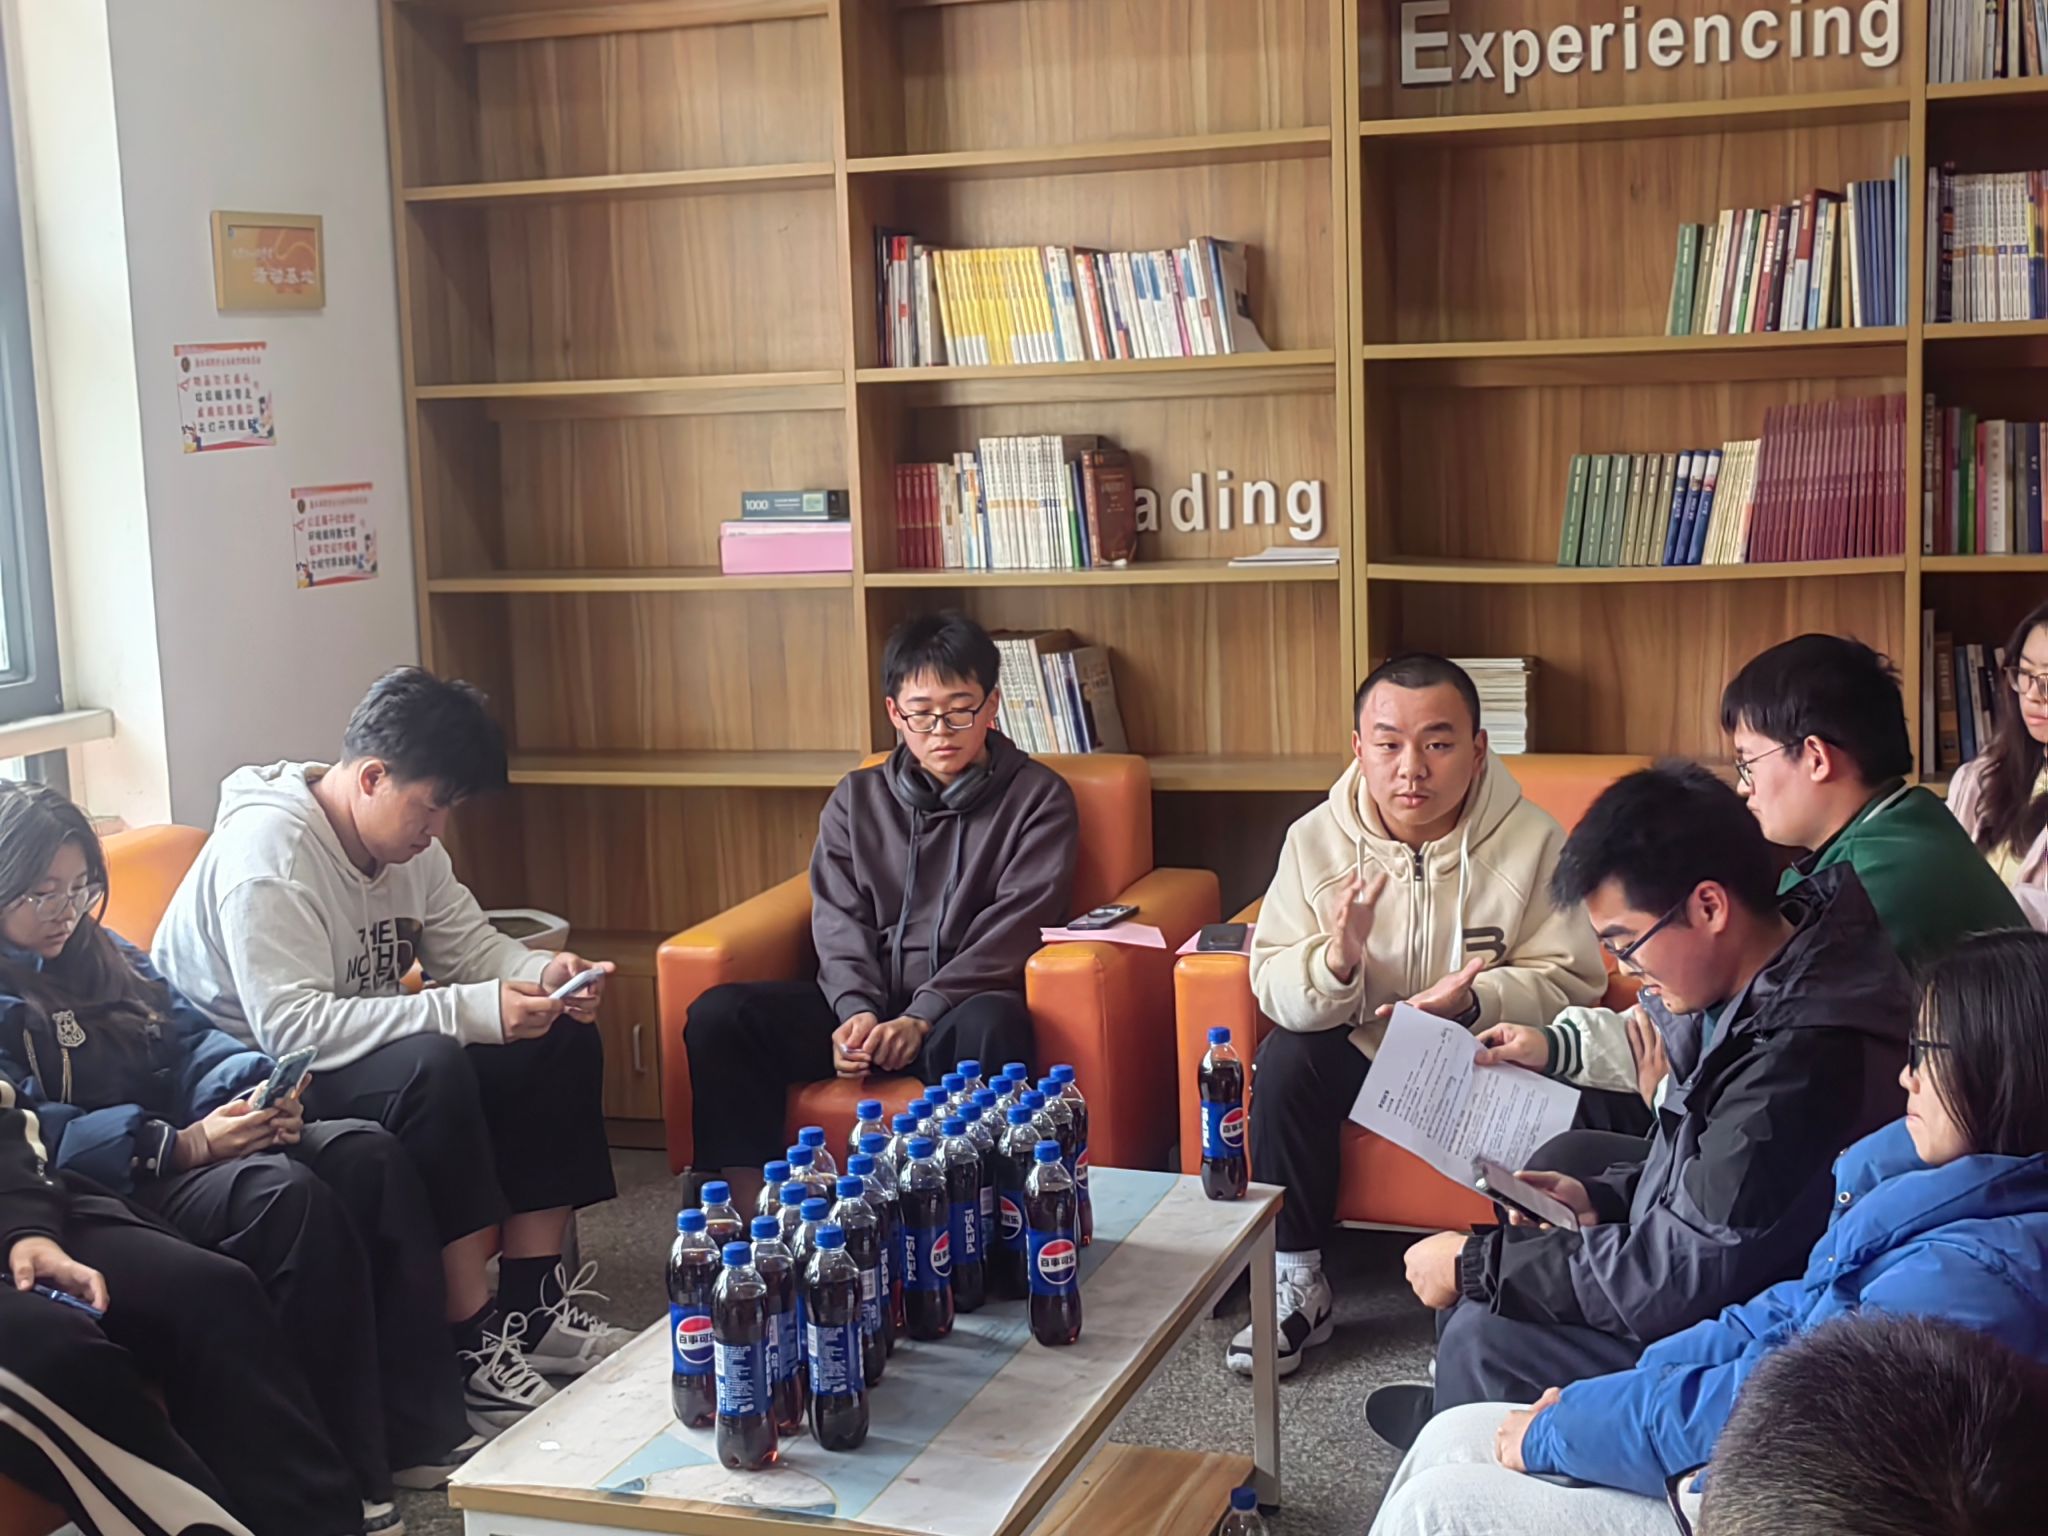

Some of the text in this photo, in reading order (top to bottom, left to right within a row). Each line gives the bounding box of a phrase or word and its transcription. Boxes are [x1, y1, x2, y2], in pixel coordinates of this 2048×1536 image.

[1401, 0, 1899, 94] Experiencing
[745, 499, 769, 511] 1000
[964, 1208, 976, 1254] PEPSI
[905, 1235, 918, 1282] PEPSI
[1040, 1253, 1075, 1268] 百事可乐
